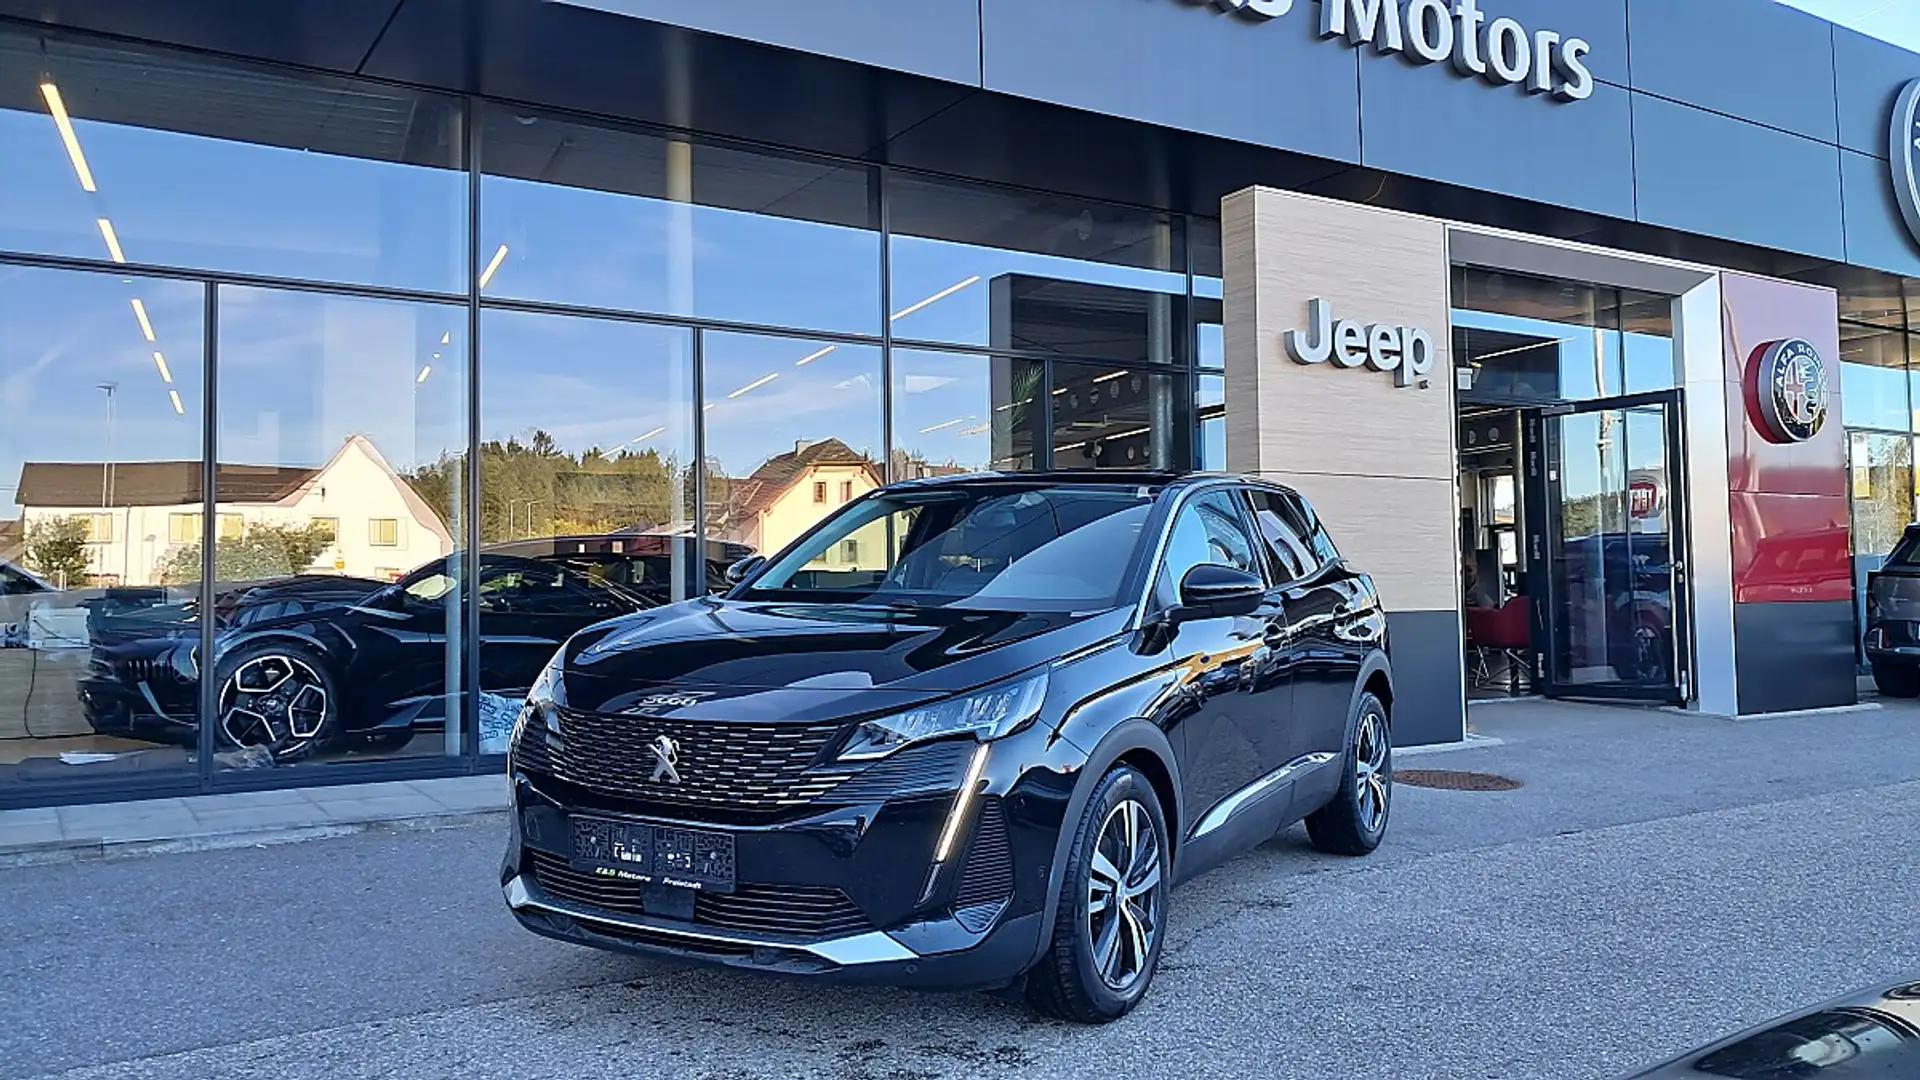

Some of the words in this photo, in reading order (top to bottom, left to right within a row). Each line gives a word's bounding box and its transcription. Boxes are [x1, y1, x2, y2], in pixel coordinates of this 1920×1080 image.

[1318, 0, 1593, 100] Motors
[1284, 298, 1434, 388] Jeep
[1775, 347, 1795, 387] ALFA
